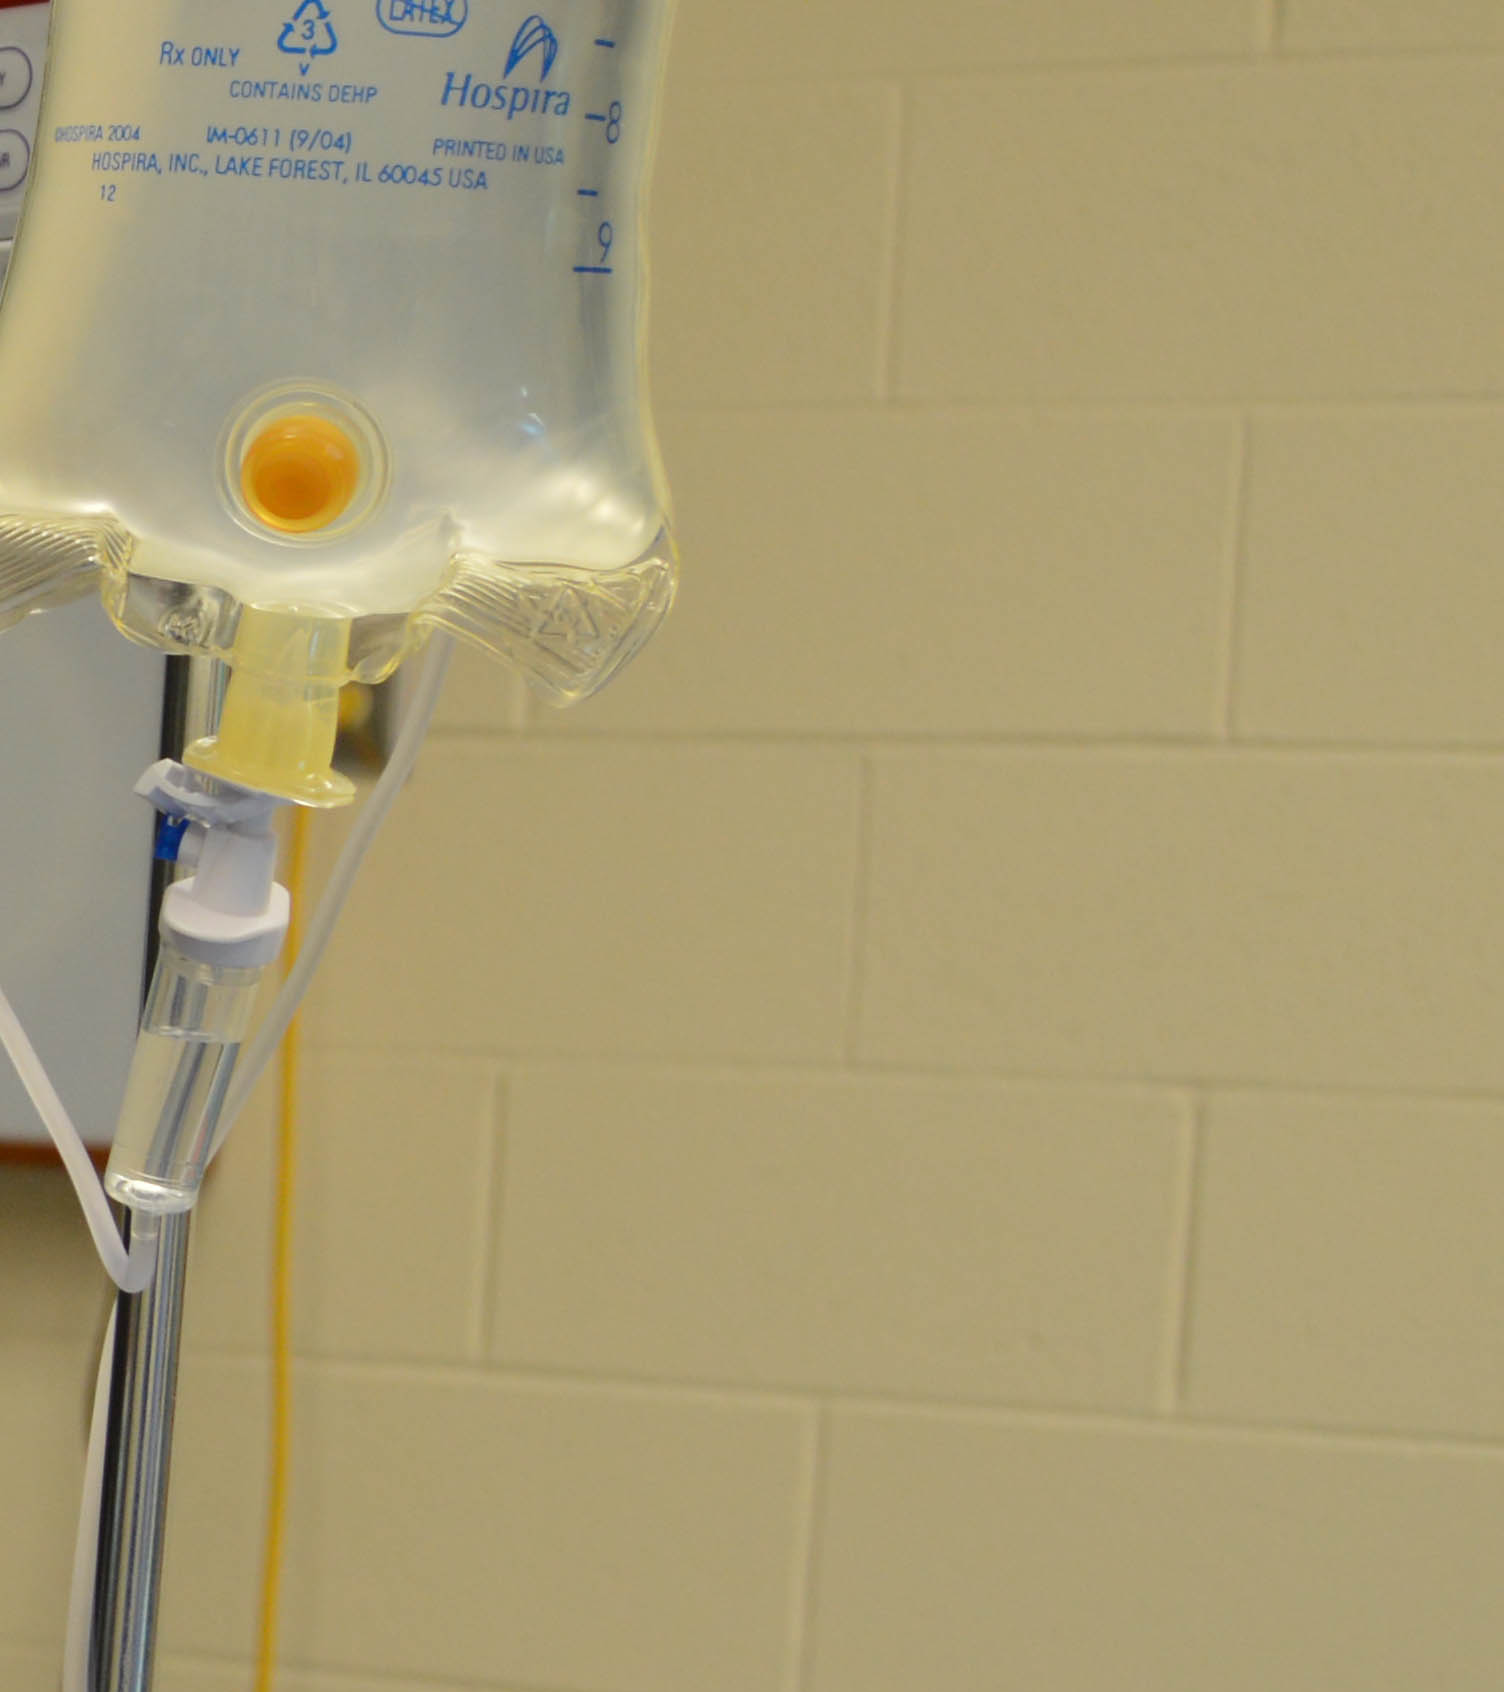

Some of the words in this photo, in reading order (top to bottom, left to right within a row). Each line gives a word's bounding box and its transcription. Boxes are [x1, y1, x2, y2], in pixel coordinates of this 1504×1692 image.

[159, 41, 185, 66] Rx
[191, 47, 240, 67] ONLY
[229, 80, 322, 101] CONTAINS
[328, 84, 377, 104] DEHP
[440, 71, 571, 121] Hospira
[107, 125, 141, 142] 2004
[289, 129, 352, 152] (9/04)
[432, 138, 506, 161] PRINTED
[512, 145, 529, 161] IN
[534, 147, 565, 165] USA
[91, 152, 162, 176] HOSPIRA,
[169, 154, 208, 177] INC.,
[215, 155, 264, 177] LAKE
[268, 158, 349, 185] FOREST,
[355, 163, 372, 182] IL
[377, 164, 443, 187] 60045
[448, 169, 489, 190] USA
[99, 184, 116, 202] 12
